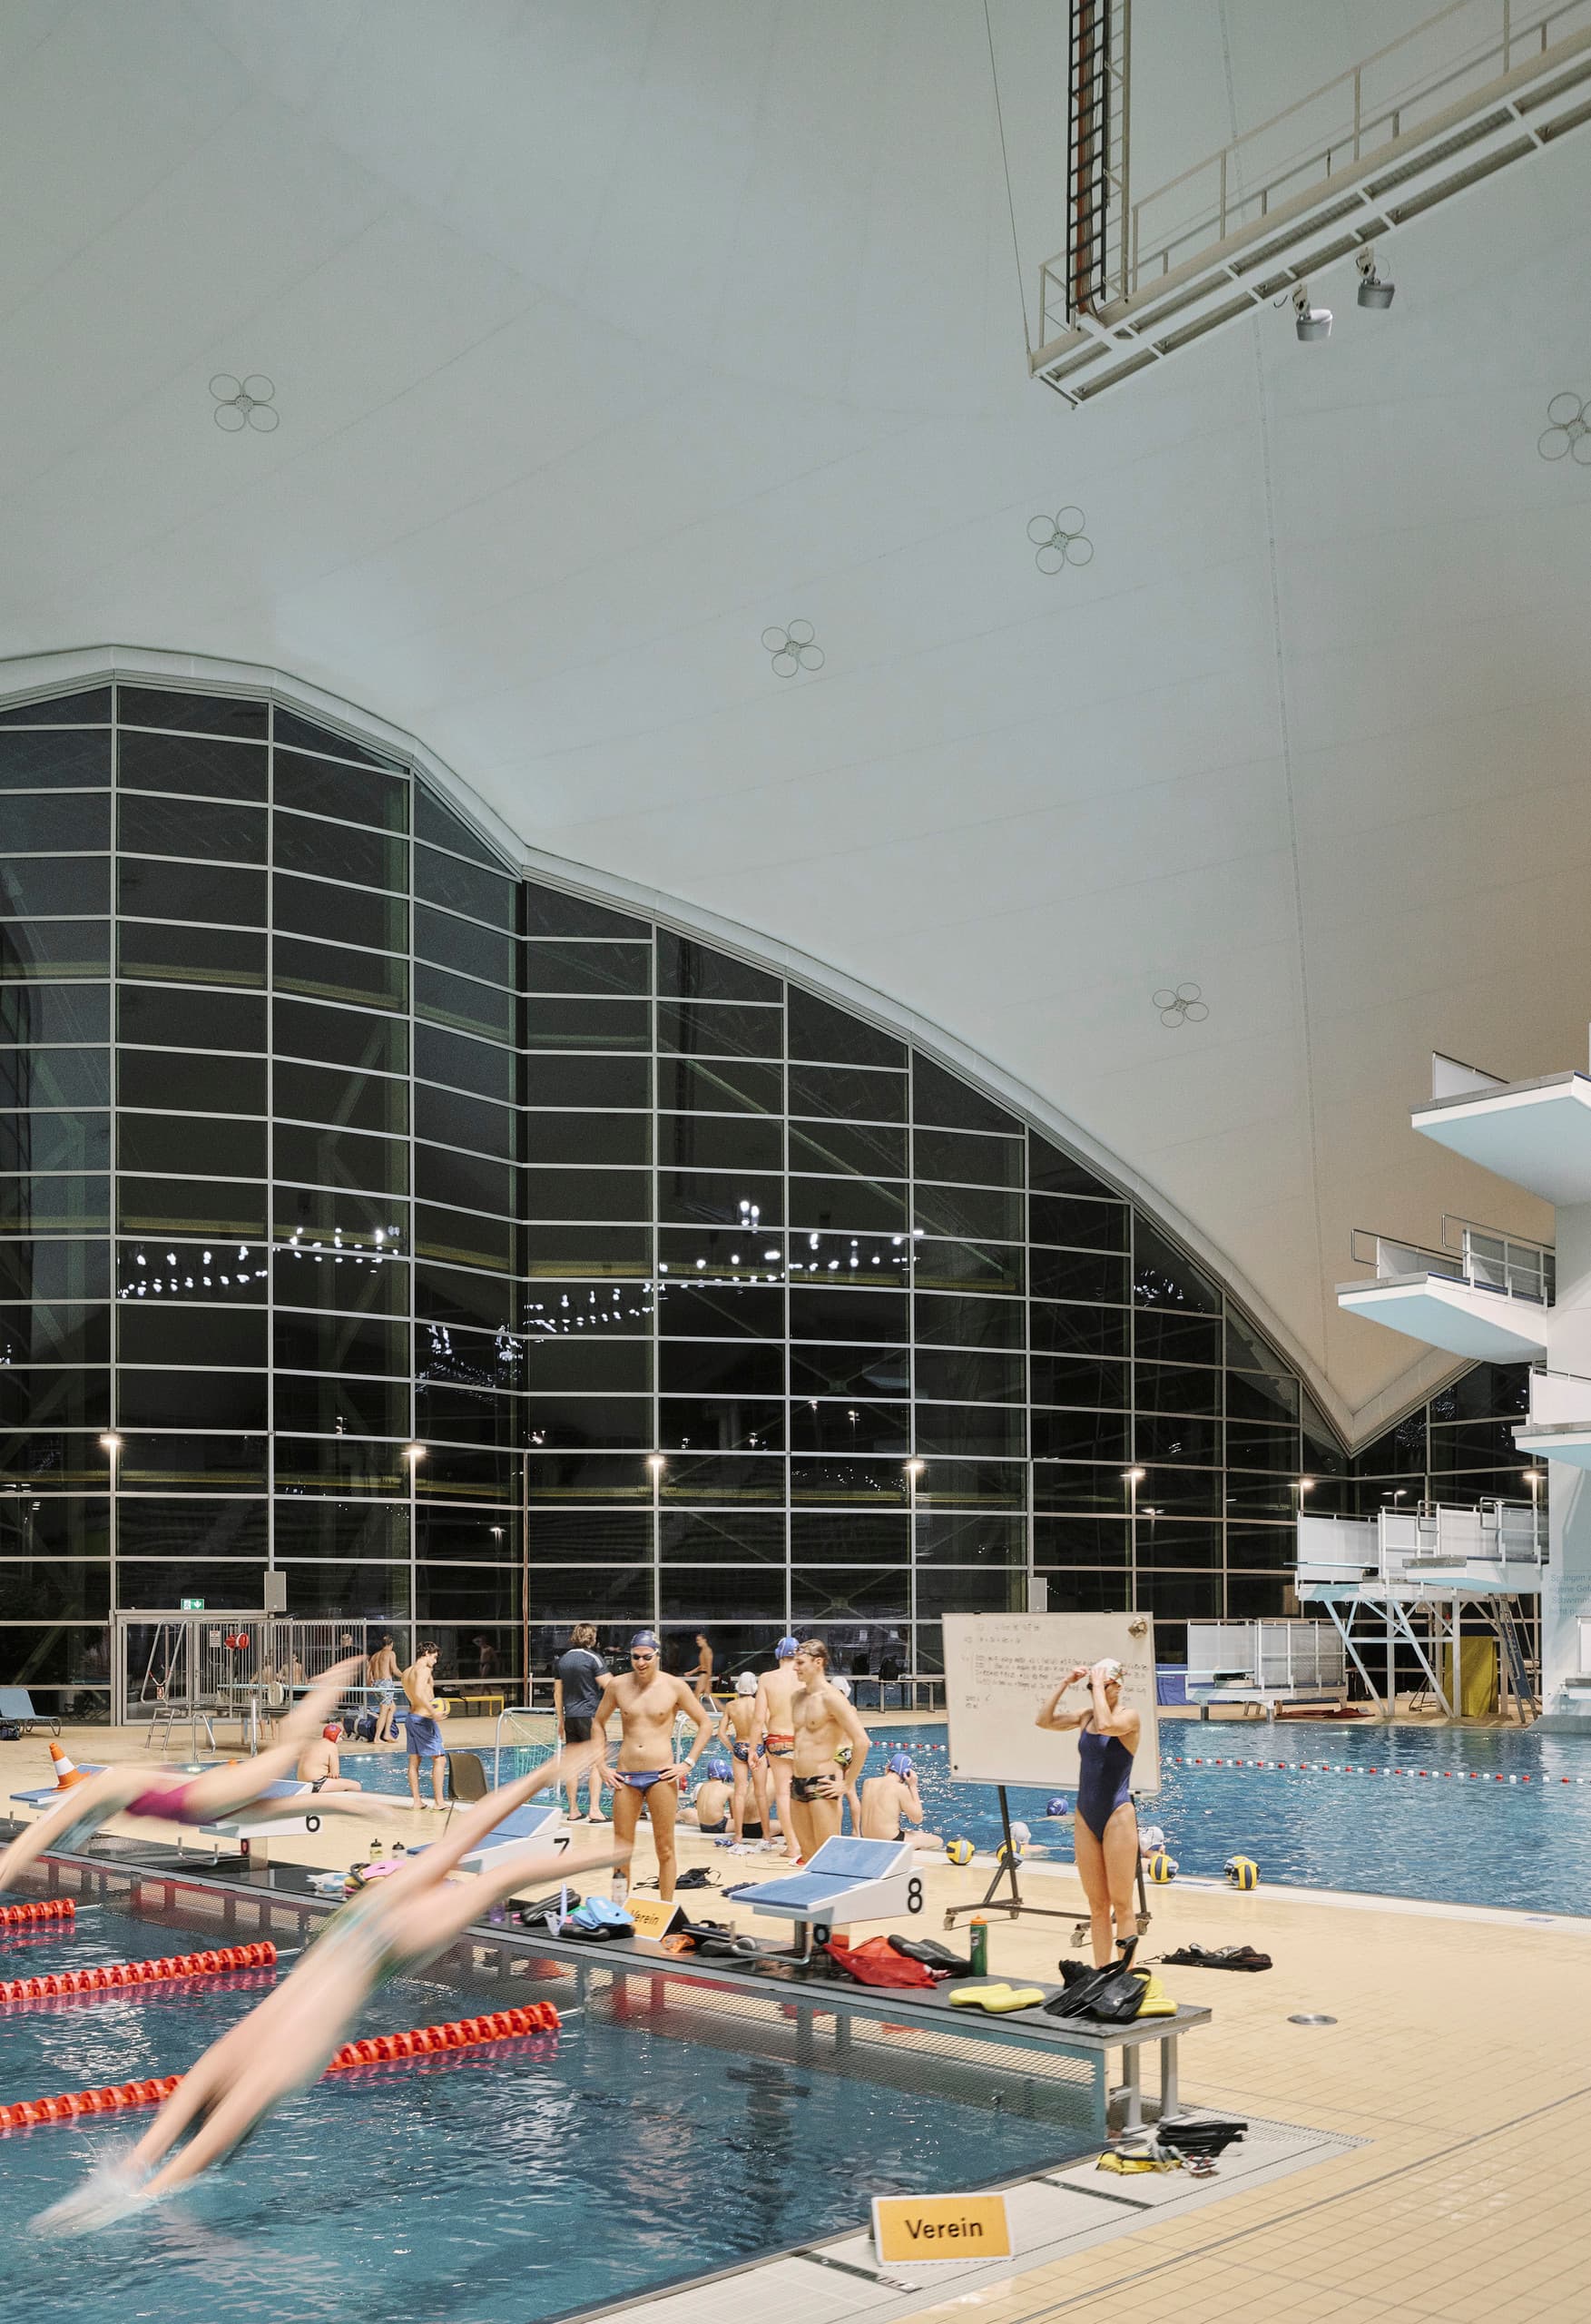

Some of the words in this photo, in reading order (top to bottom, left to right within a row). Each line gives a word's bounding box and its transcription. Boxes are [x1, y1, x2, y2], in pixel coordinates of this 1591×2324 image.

[305, 1815, 320, 1833] 6
[908, 1877, 923, 1914] 8
[905, 2218, 984, 2240] Verein
